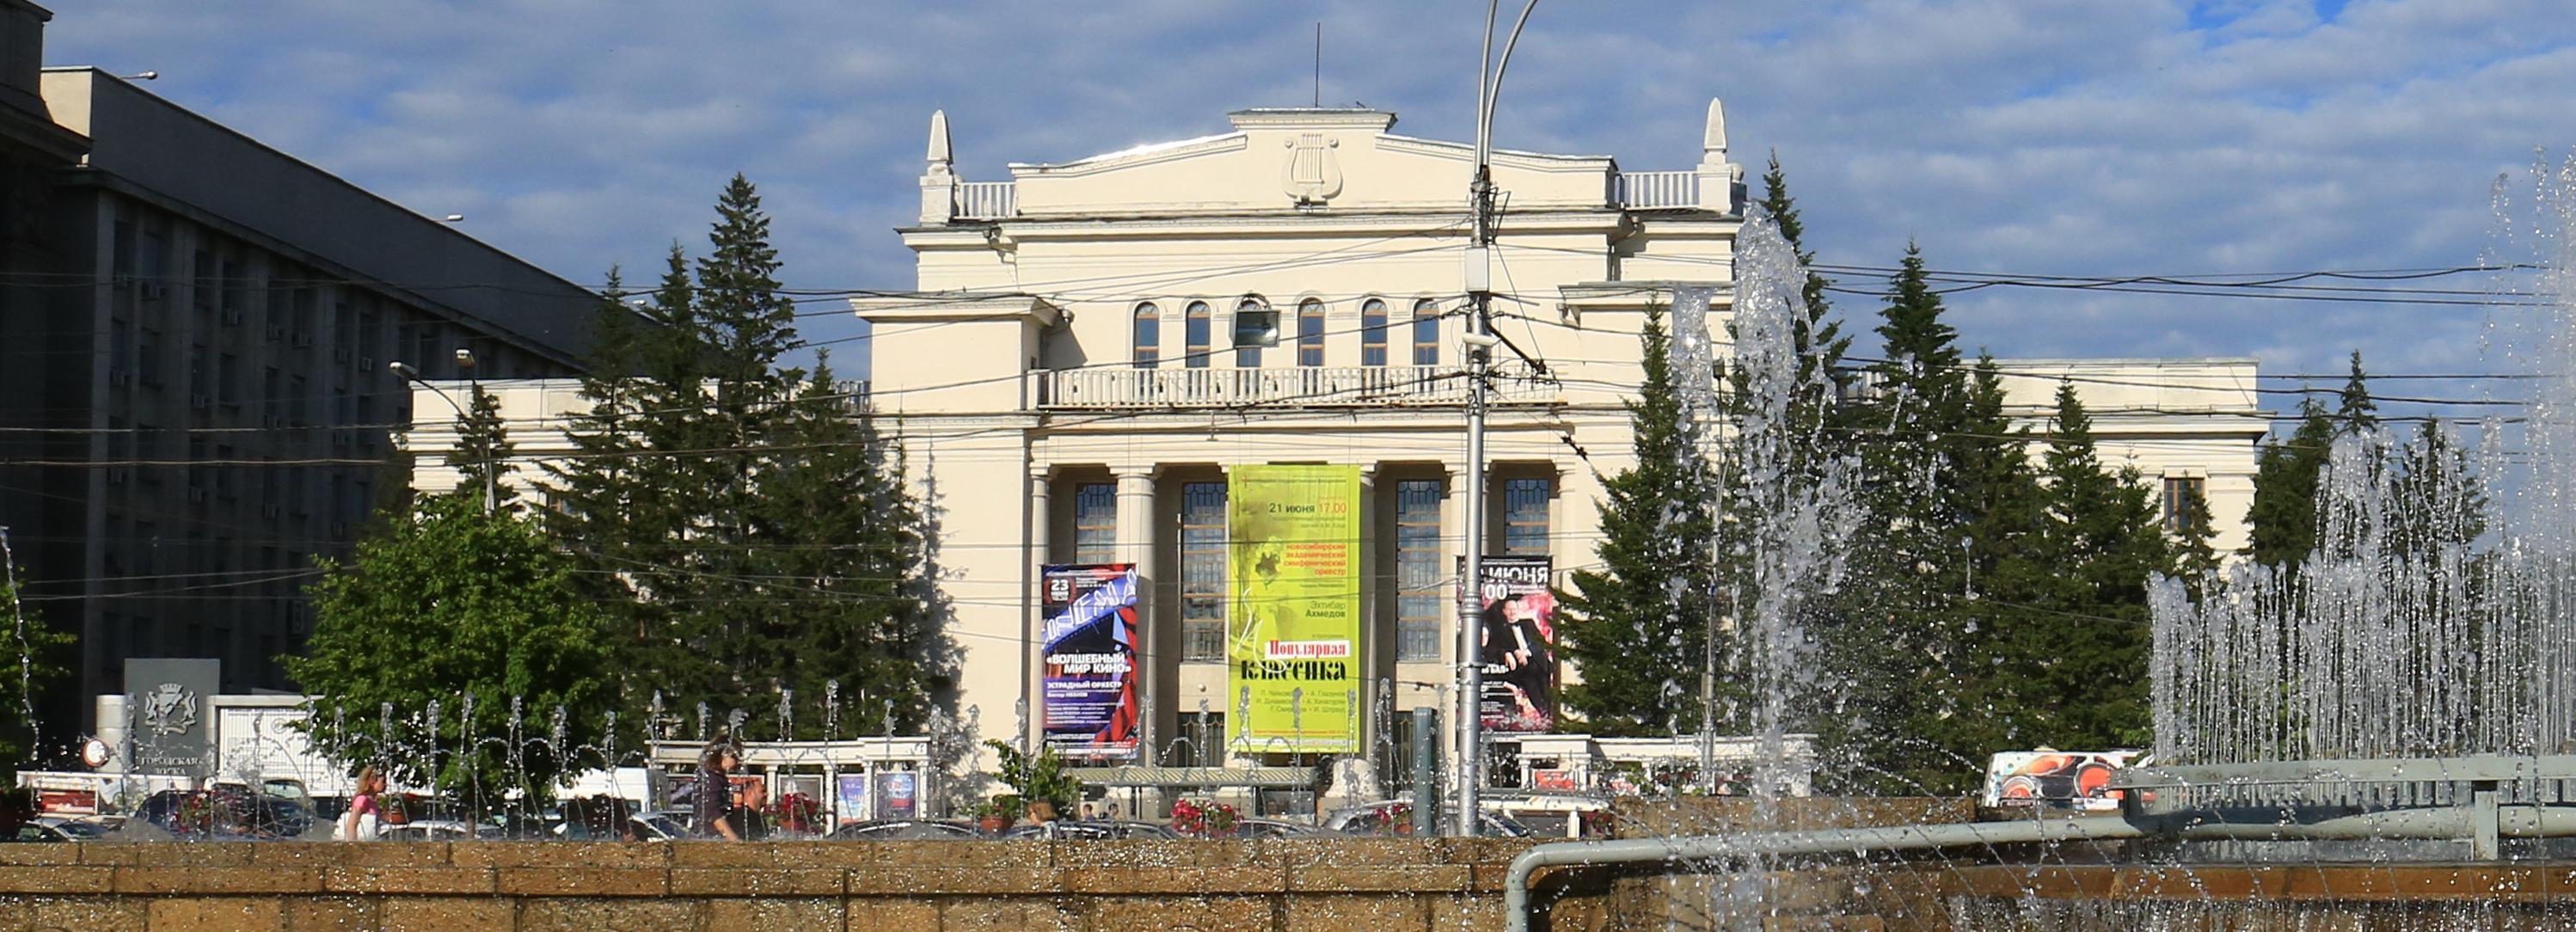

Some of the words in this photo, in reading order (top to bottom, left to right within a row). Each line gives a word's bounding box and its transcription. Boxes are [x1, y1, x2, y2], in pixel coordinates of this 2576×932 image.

[1269, 503, 1282, 513] 21
[1285, 505, 1316, 513] июня
[1319, 503, 1347, 513] 17.00
[1051, 579, 1069, 591] 23
[1309, 601, 1346, 610] Эхтибар
[1305, 610, 1346, 618] Ахмедов
[1269, 640, 1346, 659] Популярная
[1046, 652, 1125, 664] «ВОЛШЕБНЫЙ
[1064, 664, 1091, 674] МИР
[1093, 664, 1132, 674] КИНО»
[1241, 660, 1346, 681] классика
[1046, 680, 1090, 690] ЭСТРАДНЫЙ
